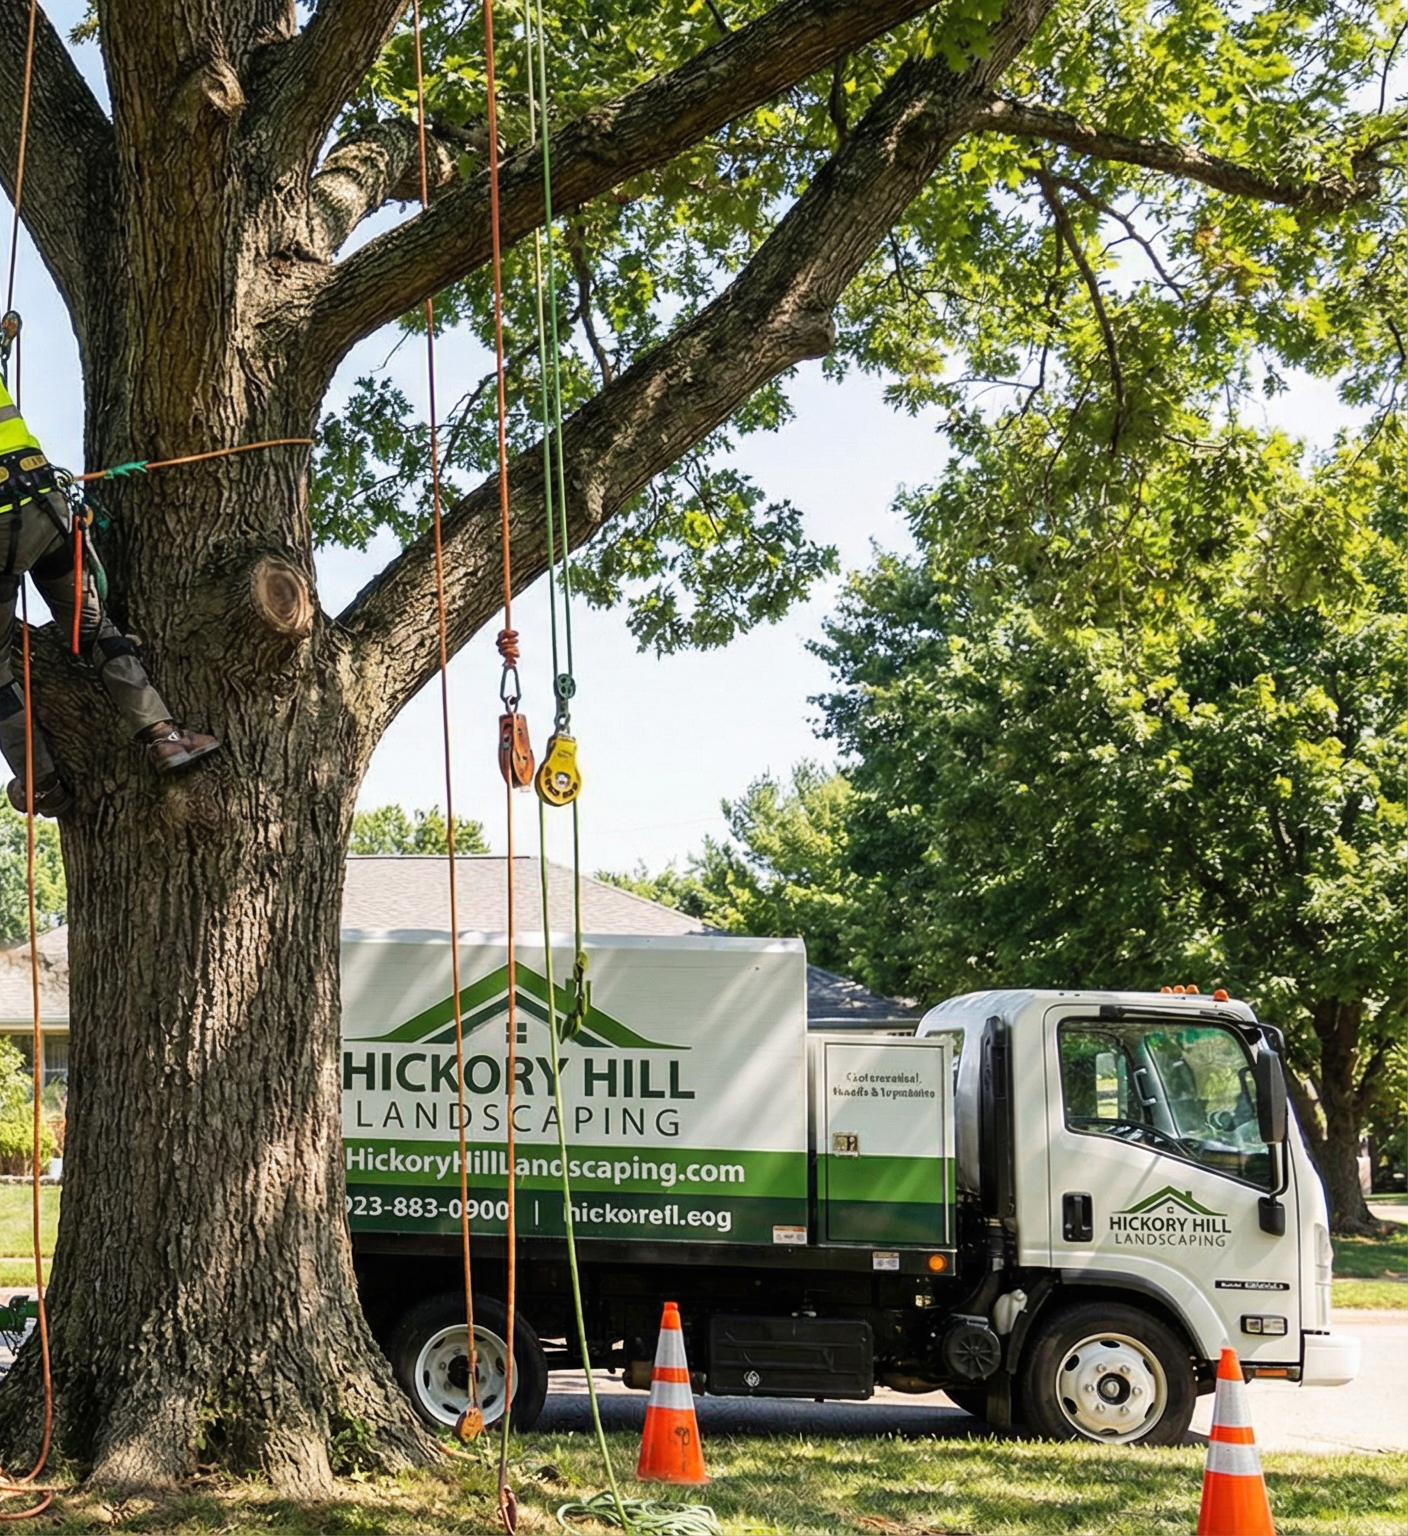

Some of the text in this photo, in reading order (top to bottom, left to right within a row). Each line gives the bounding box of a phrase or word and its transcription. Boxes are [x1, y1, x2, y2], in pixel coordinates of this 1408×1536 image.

[343, 1052, 695, 1099] HICKORY HILL
[357, 1100, 680, 1136] LANDSCAPING
[345, 1147, 745, 1187] HickoryHillLandscaping.com
[1109, 1216, 1232, 1233] HICKORY HILL
[1115, 1233, 1226, 1247] LANDSCAPING
